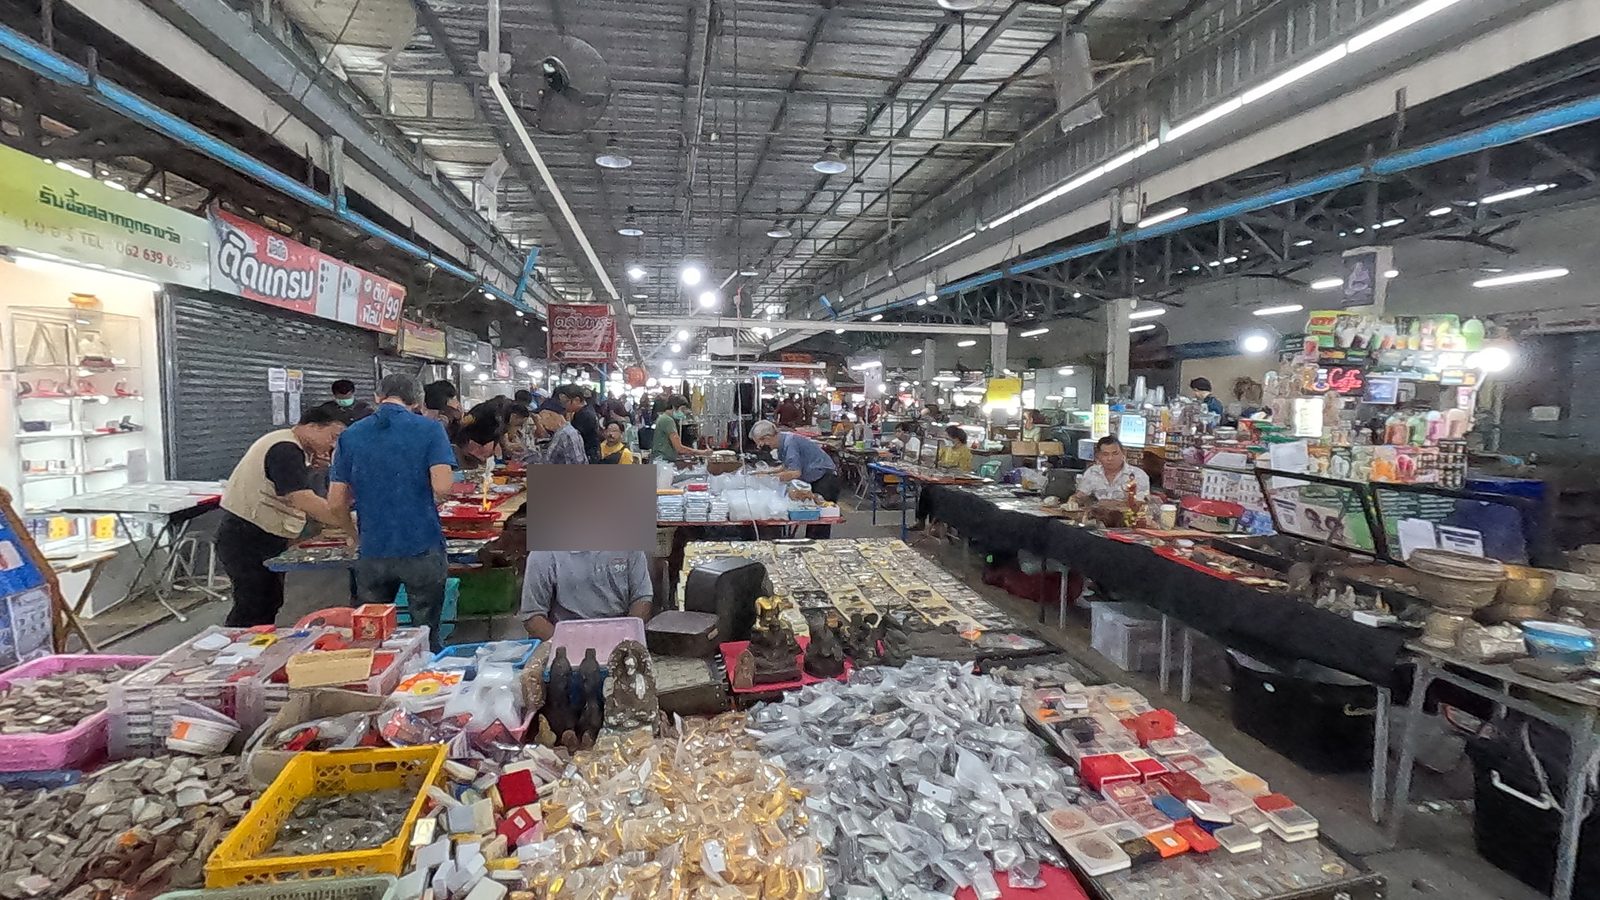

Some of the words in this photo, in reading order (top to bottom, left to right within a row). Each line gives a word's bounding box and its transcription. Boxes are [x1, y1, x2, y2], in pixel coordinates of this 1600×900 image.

[38, 184, 181, 245] รับซื้อสลากถูกรางวัล
[143, 248, 164, 264] 639
[219, 230, 315, 299] ติดแกรม
[384, 295, 400, 321] 99
